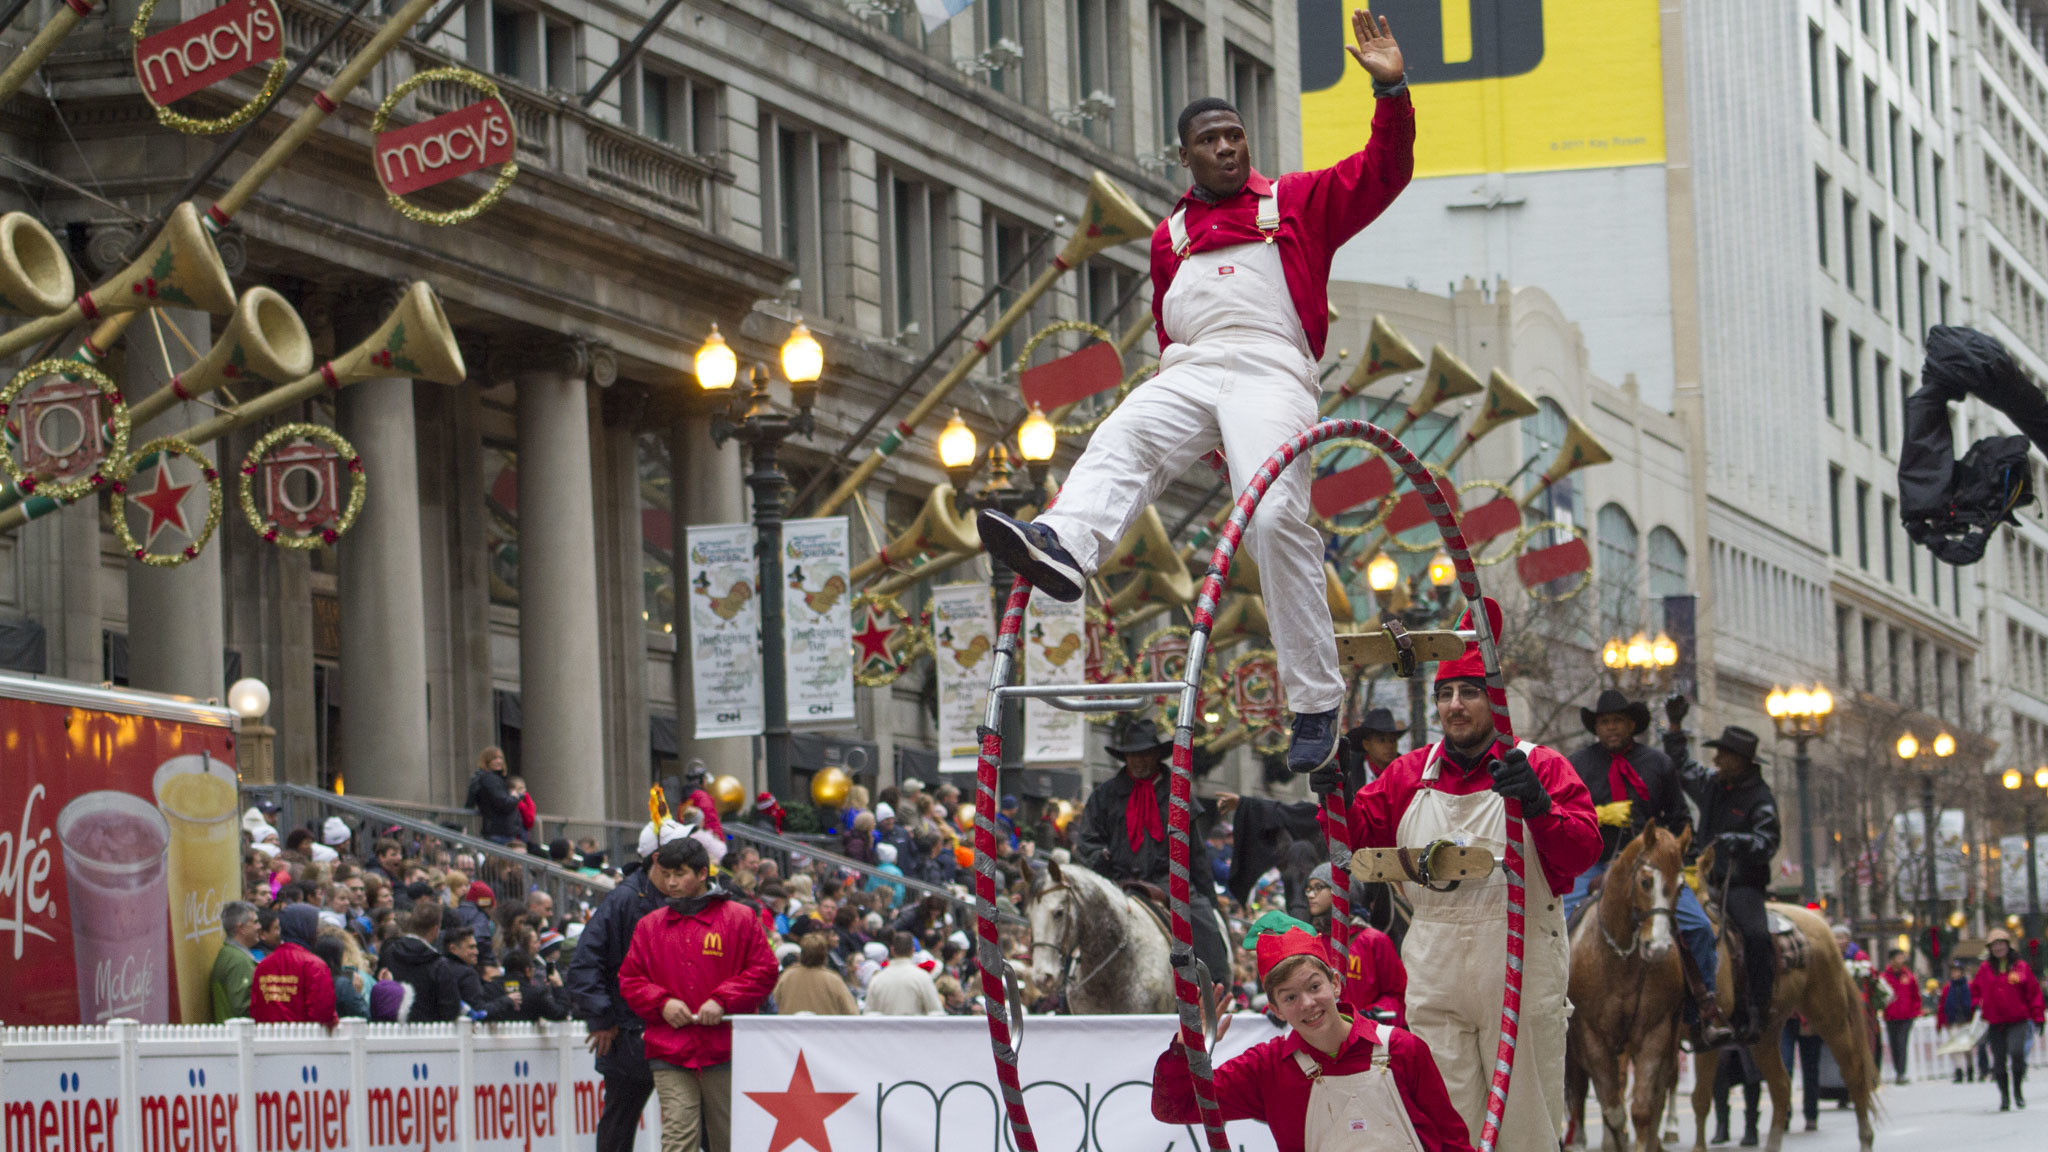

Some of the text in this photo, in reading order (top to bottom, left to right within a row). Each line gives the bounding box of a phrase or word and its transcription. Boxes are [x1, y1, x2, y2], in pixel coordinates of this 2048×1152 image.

[141, 0, 276, 93] macy's
[381, 105, 509, 184] macy's
[255, 1065, 350, 1152] meijer
[368, 1063, 459, 1152] meijer
[474, 1060, 557, 1152] meijer
